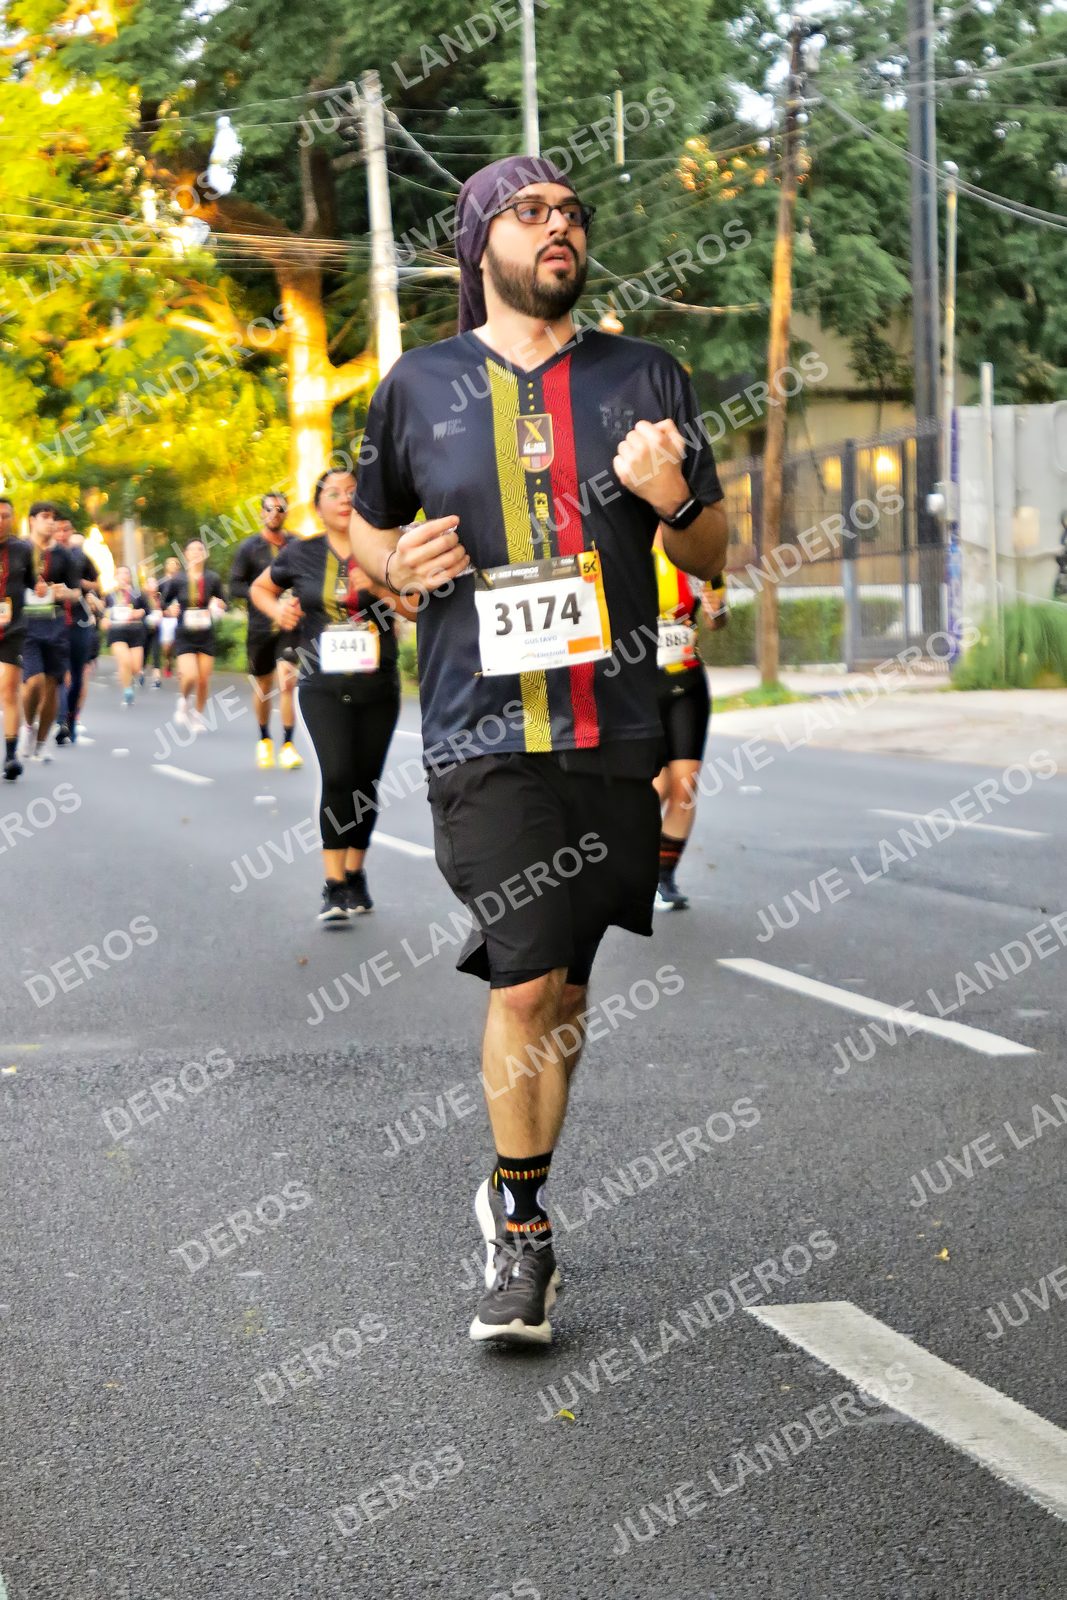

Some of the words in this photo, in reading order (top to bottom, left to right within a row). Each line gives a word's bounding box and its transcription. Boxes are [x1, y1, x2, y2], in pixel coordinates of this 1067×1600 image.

[583, 561, 597, 573] 5K
[494, 592, 582, 636] 3174
[331, 638, 367, 653] 3441
[524, 635, 558, 645] GUSTAVO
